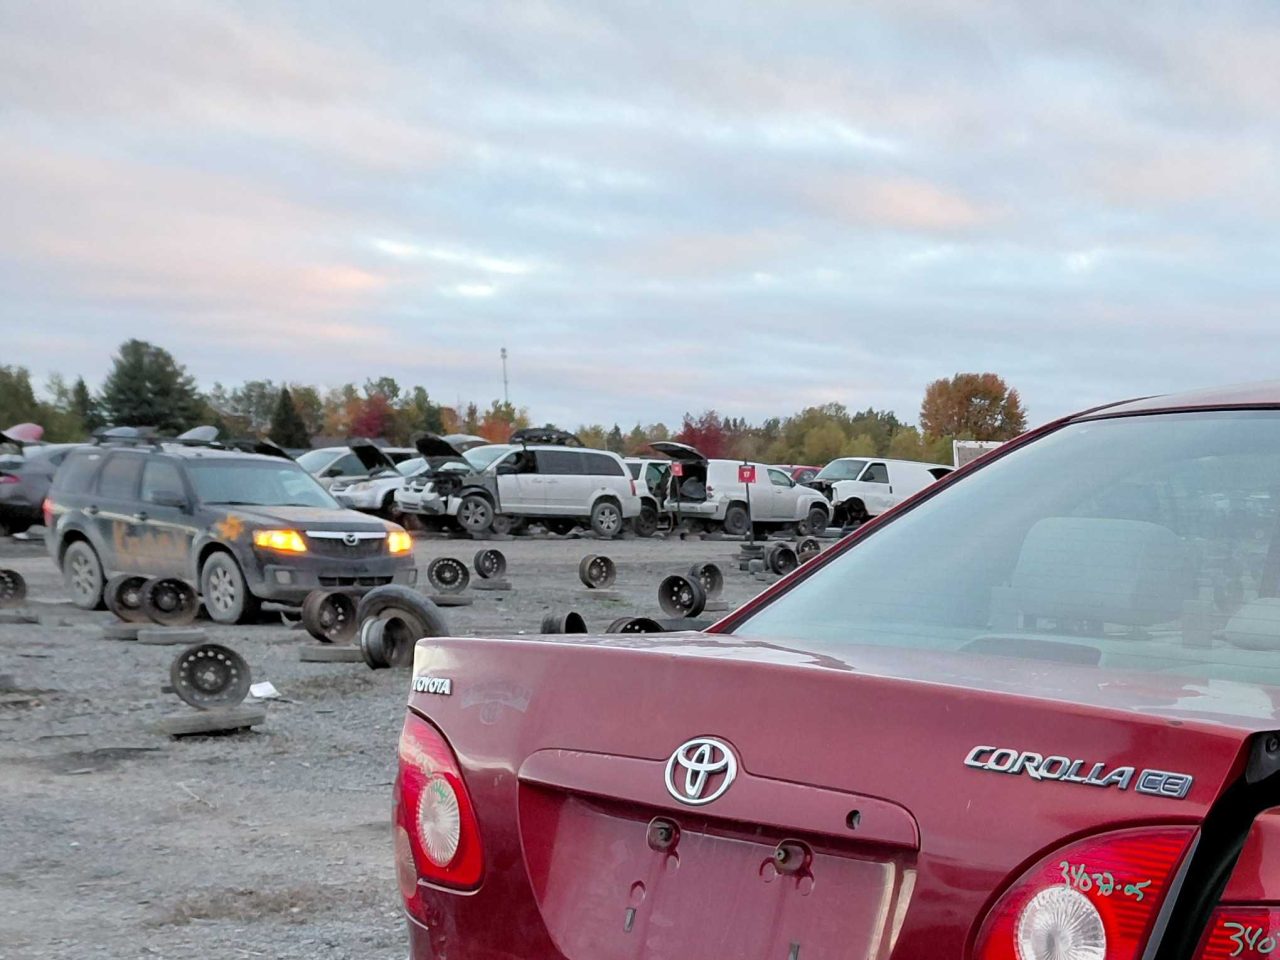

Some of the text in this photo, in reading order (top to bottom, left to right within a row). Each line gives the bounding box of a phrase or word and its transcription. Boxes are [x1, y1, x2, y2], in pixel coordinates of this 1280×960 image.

[412, 676, 453, 696] TOYOTA
[963, 745, 1190, 797] COROLLA CE
